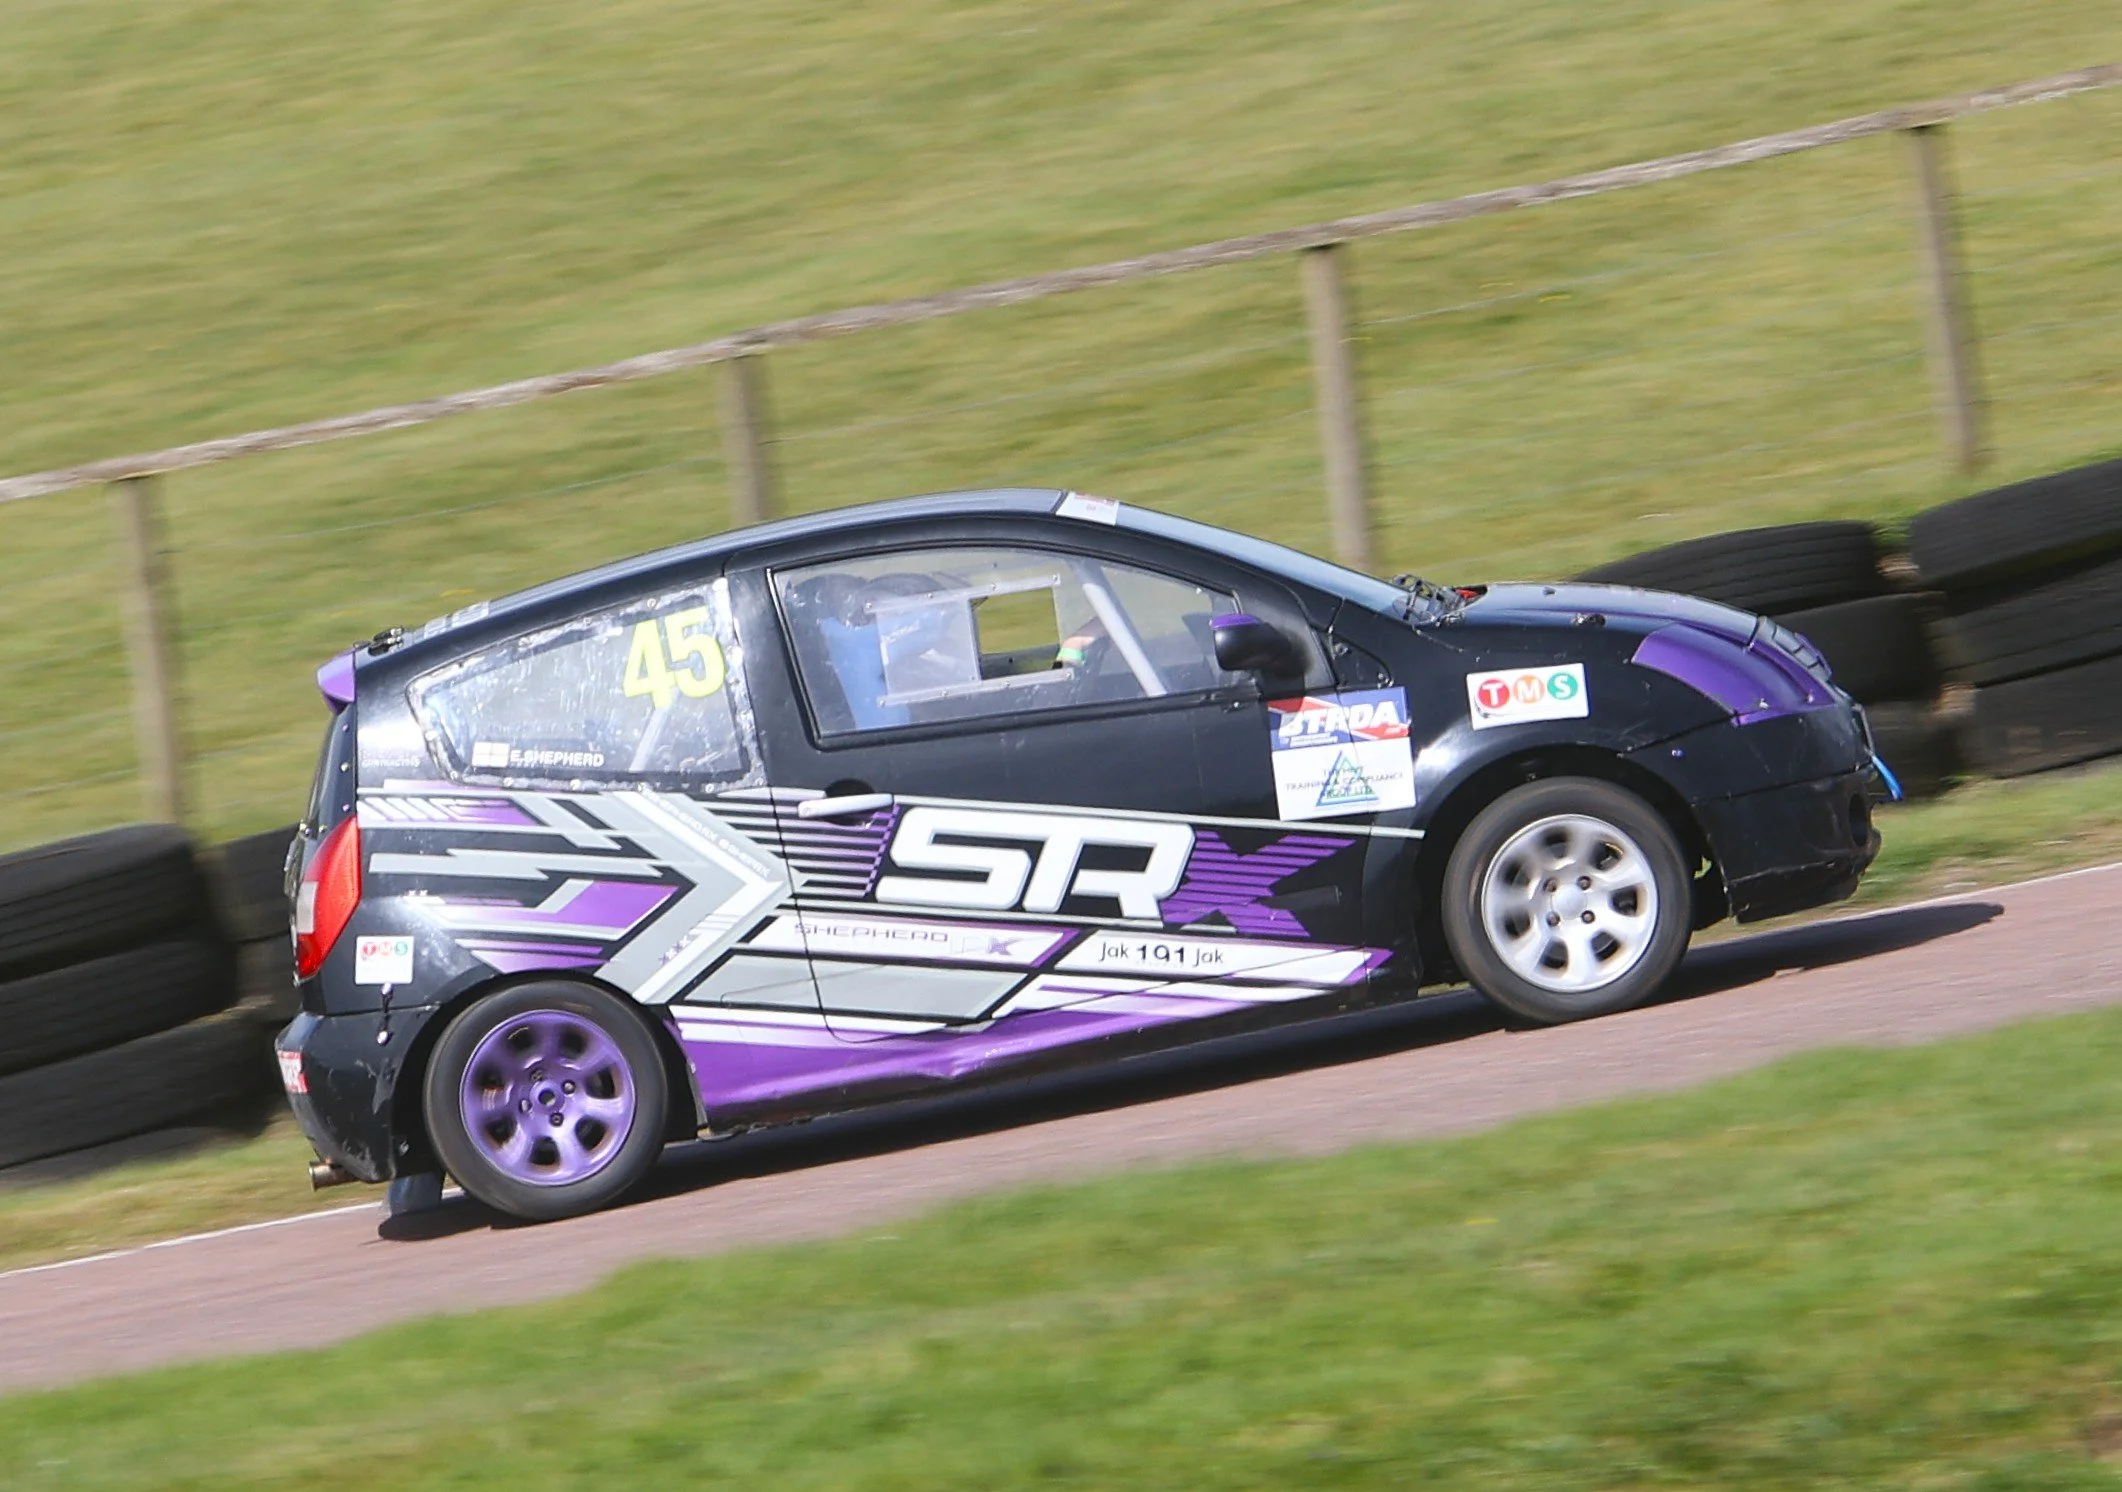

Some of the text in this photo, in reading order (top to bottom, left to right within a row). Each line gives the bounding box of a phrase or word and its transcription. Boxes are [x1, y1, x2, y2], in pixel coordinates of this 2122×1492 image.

[623, 606, 725, 709] 45
[1481, 673, 1573, 707] TMS
[876, 806, 1357, 938] SRX
[795, 923, 948, 943] SHEPHERD
[1099, 942, 1129, 961] Jak
[1136, 944, 1185, 962] 191
[1193, 948, 1224, 967] Jak
